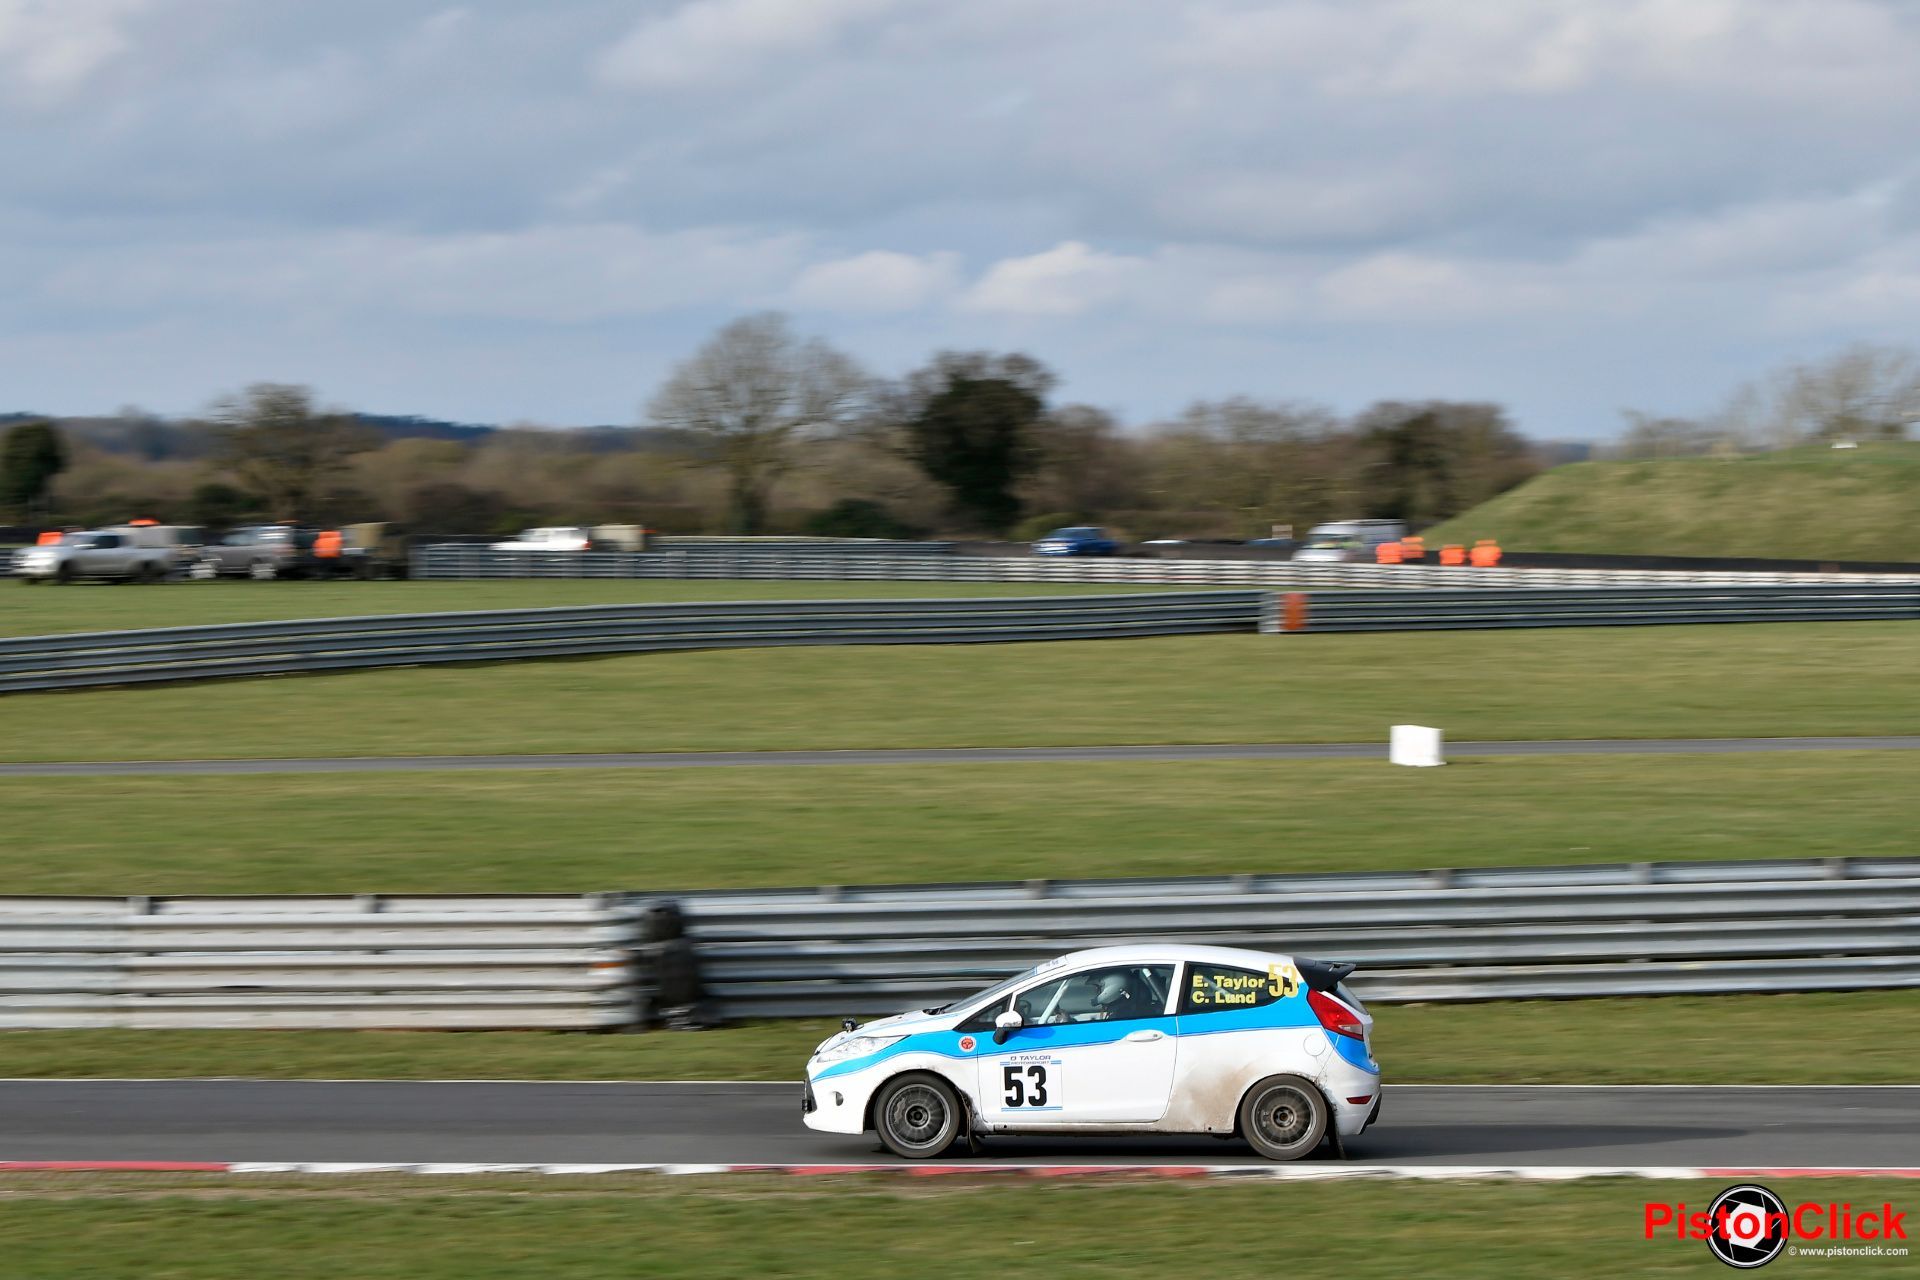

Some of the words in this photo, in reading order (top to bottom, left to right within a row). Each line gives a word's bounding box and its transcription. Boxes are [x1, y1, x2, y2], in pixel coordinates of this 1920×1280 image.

[1192, 975, 1209, 988] E.
[1213, 975, 1265, 989] Taylor
[1268, 963, 1299, 998] 53
[1192, 991, 1209, 1004] C.
[1215, 991, 1256, 1004] Lund
[1004, 1065, 1048, 1107] 53
